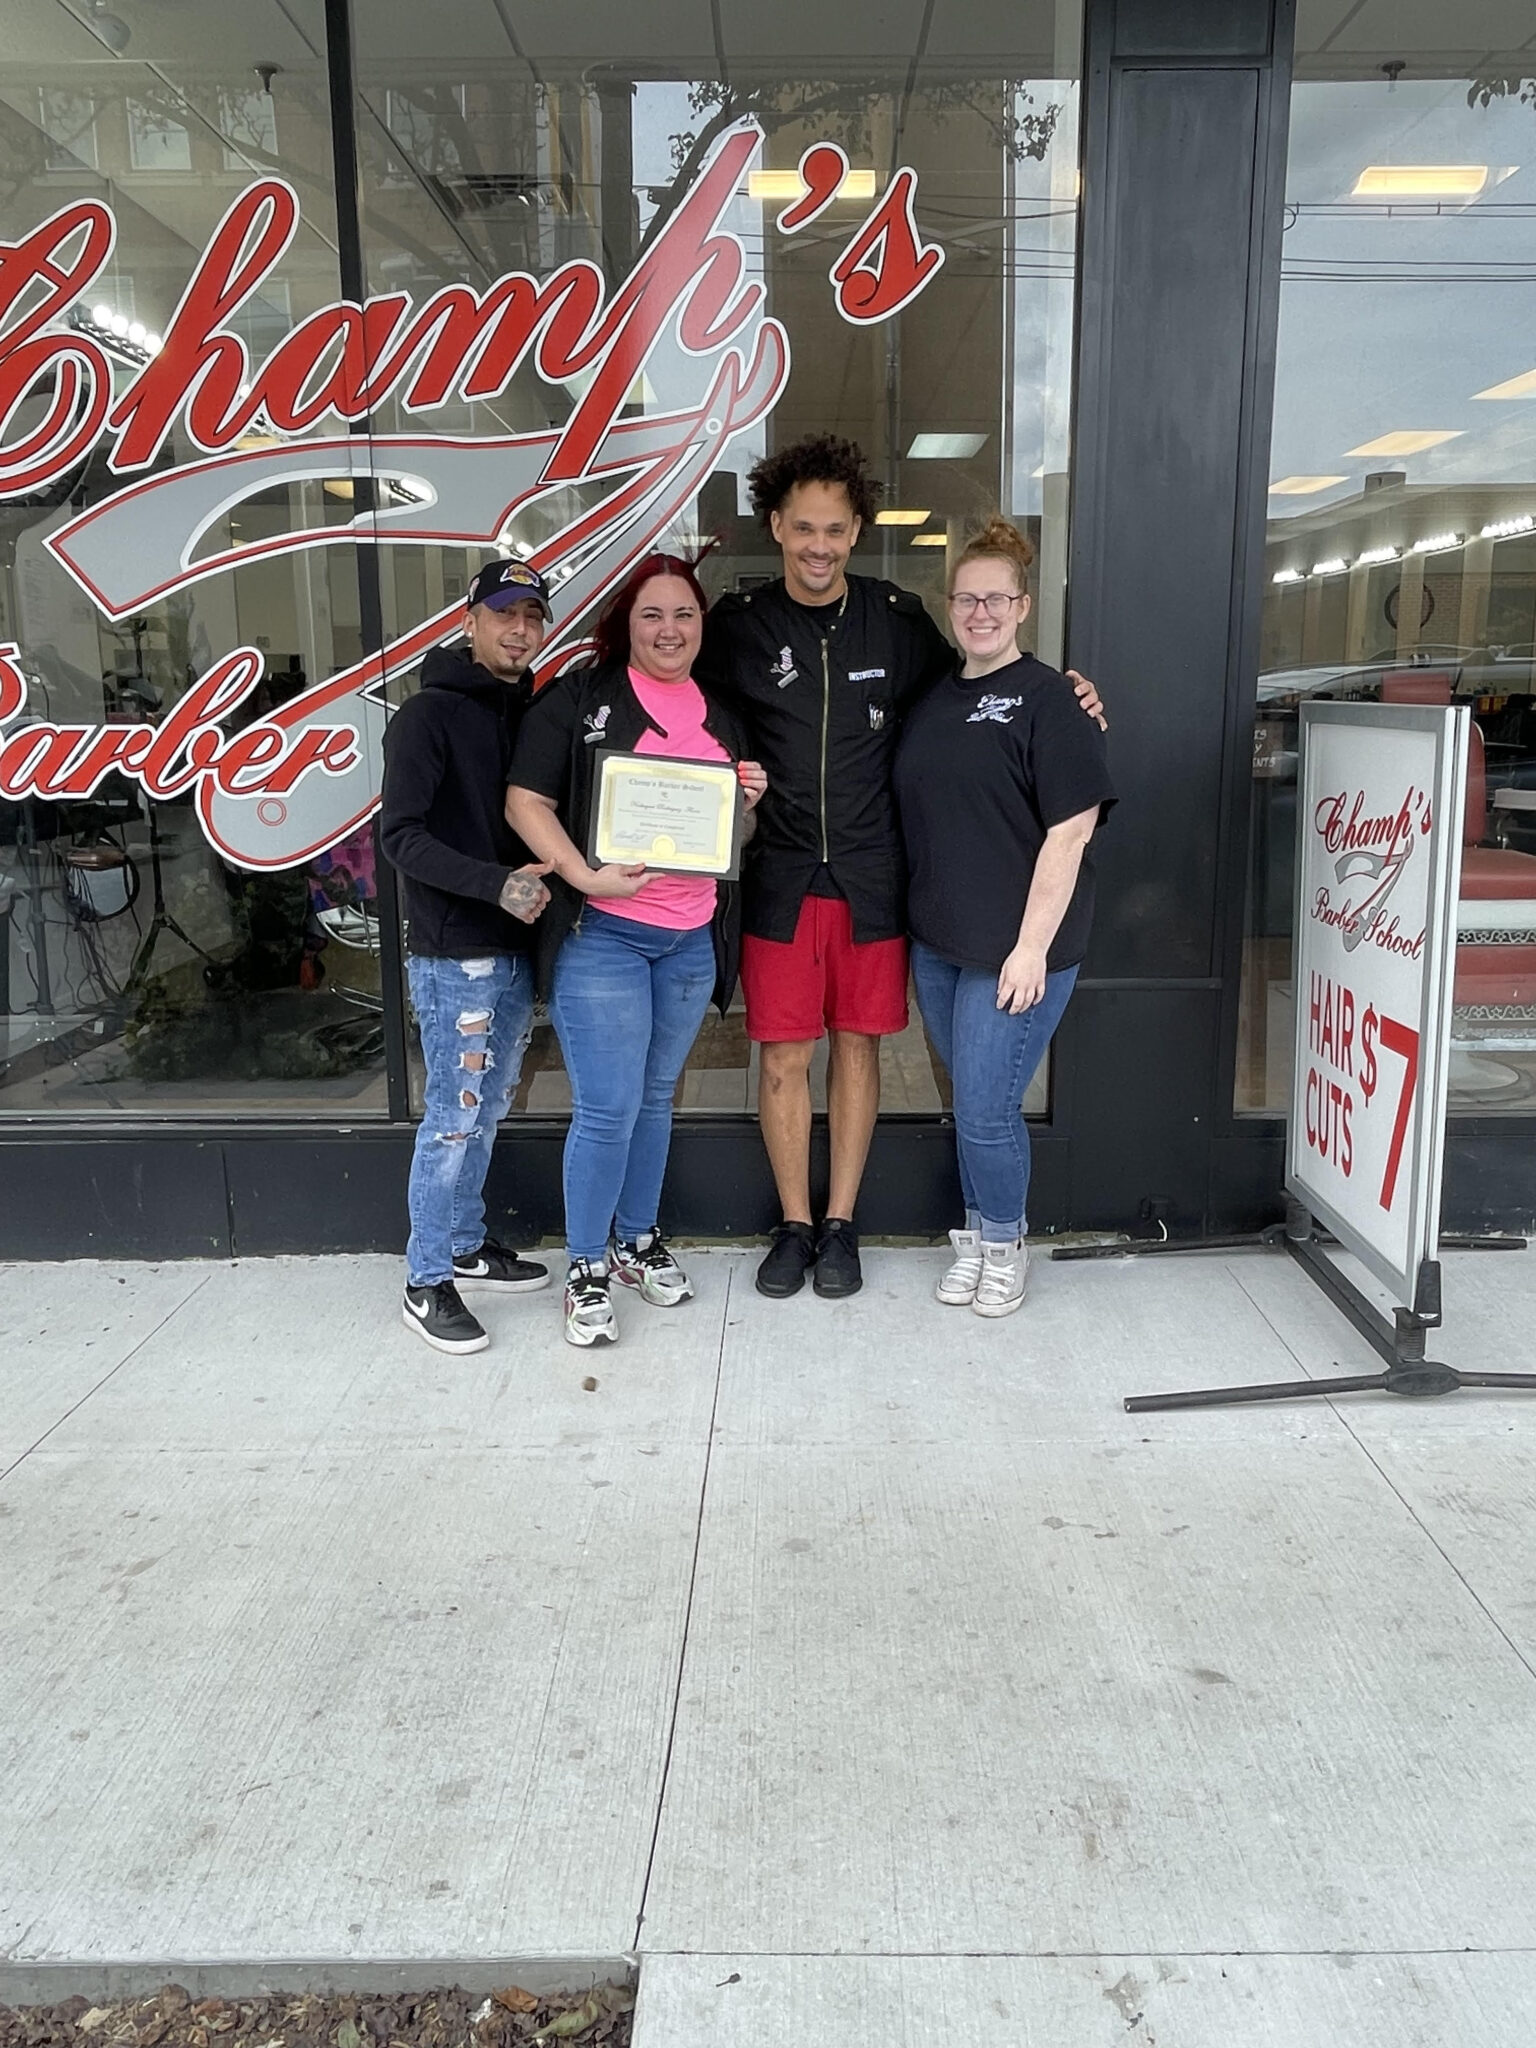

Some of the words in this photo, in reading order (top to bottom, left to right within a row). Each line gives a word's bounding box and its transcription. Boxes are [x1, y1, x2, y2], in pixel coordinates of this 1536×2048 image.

[1315, 785, 1432, 866] Champ's
[1311, 887, 1359, 934] Barber
[1362, 906, 1426, 960] School
[1309, 969, 1355, 1078] HAIR
[1306, 1066, 1353, 1178] CUTS
